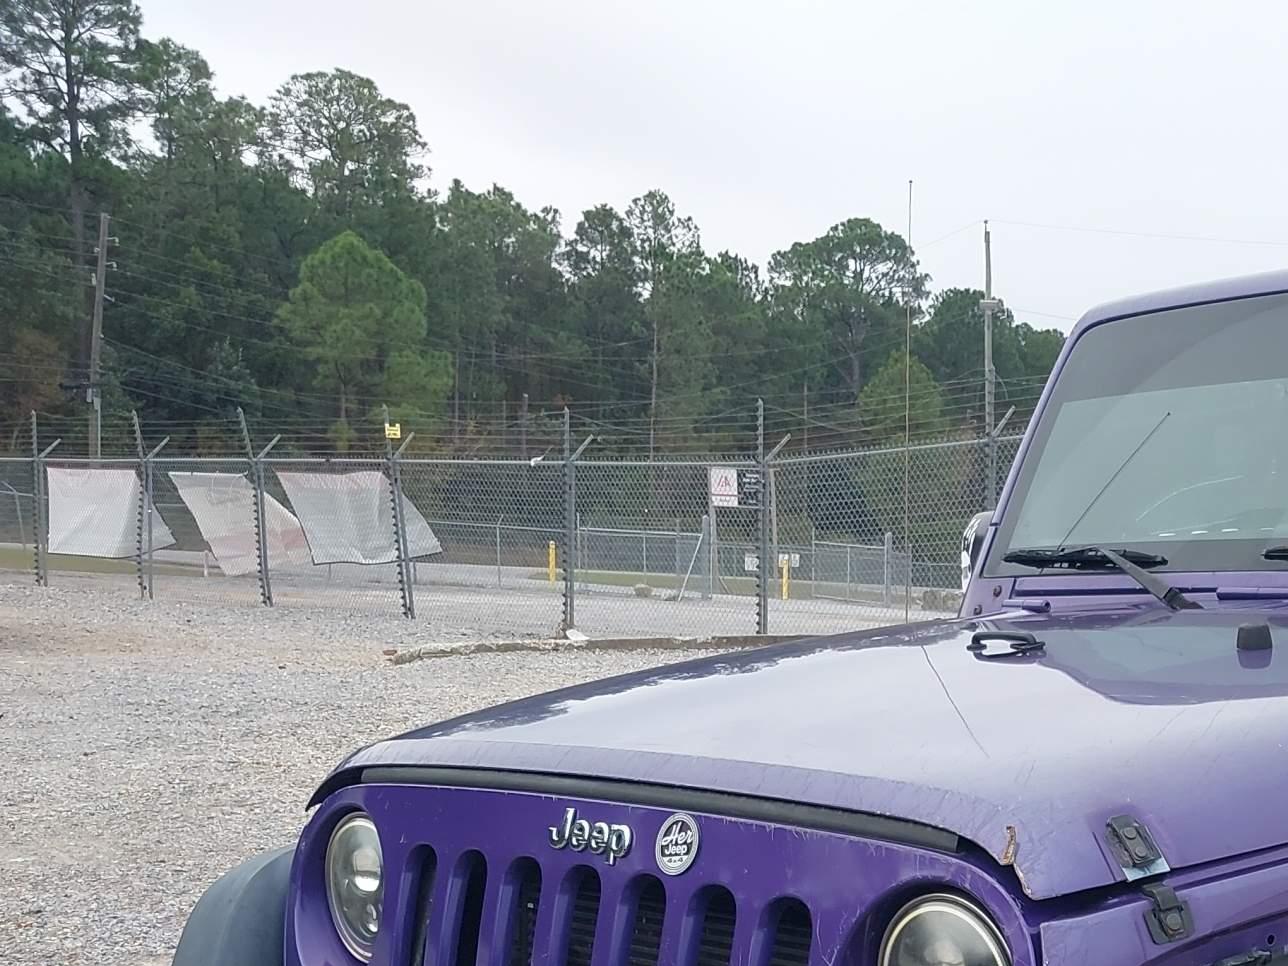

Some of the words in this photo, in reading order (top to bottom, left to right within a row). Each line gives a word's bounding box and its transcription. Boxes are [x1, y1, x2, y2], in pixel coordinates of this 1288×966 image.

[549, 807, 634, 867] Jeep
[661, 821, 694, 846] Her
[665, 843, 688, 856] Jeep
